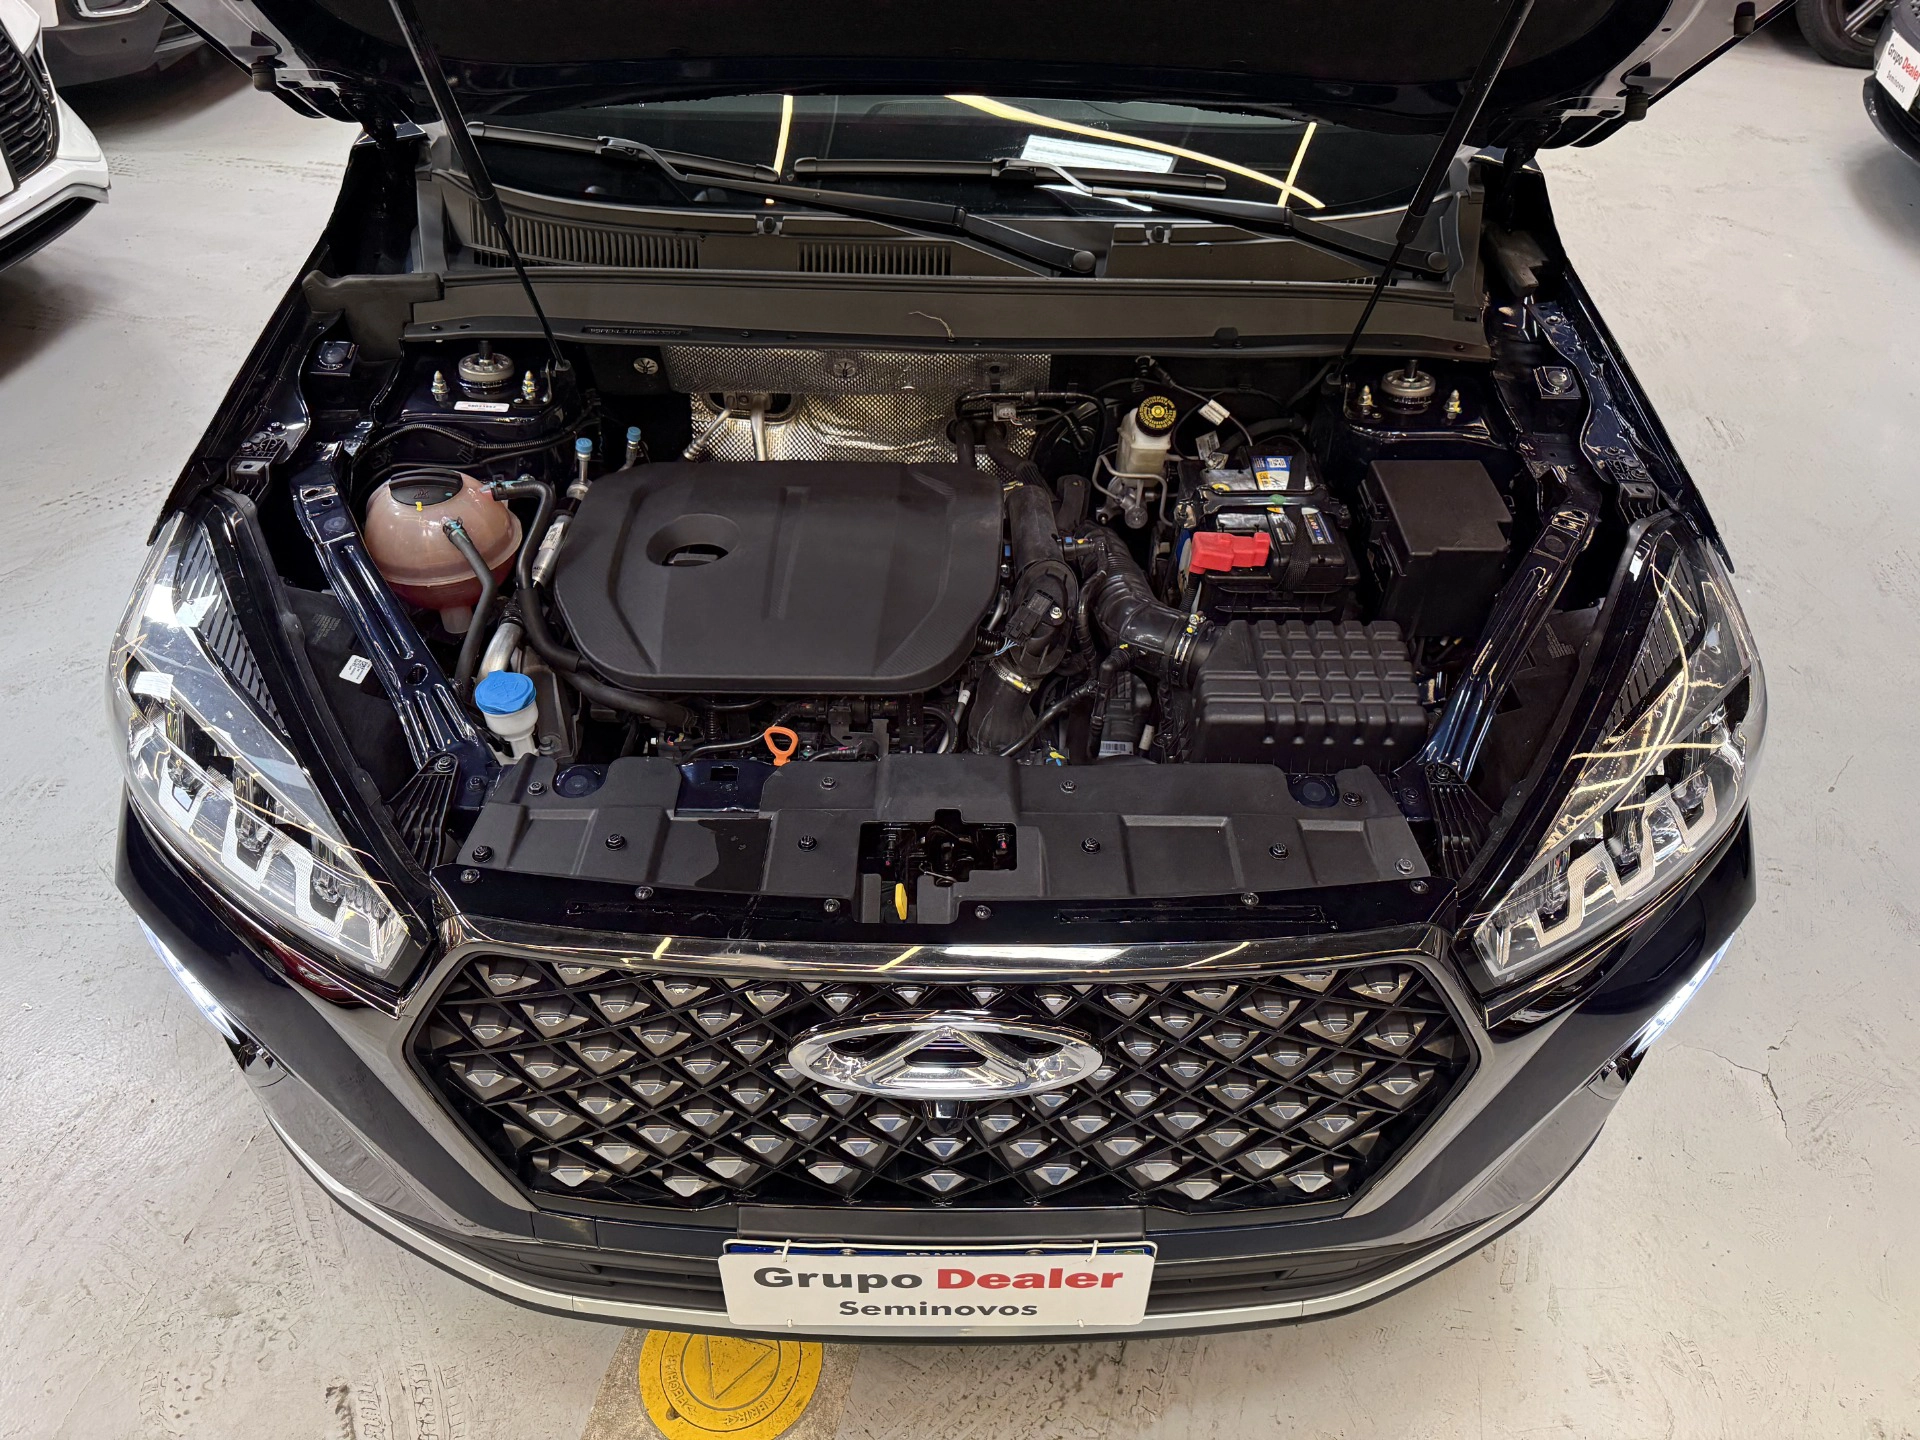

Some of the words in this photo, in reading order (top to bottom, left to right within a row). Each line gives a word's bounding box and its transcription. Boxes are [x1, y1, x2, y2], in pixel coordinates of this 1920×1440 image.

[1887, 42, 1903, 66] Grupo
[753, 1267, 923, 1294] Grupo
[937, 1267, 1124, 1290] Dealer
[838, 1300, 1039, 1317] Seminovos
[738, 1394, 775, 1422] ABRIR
